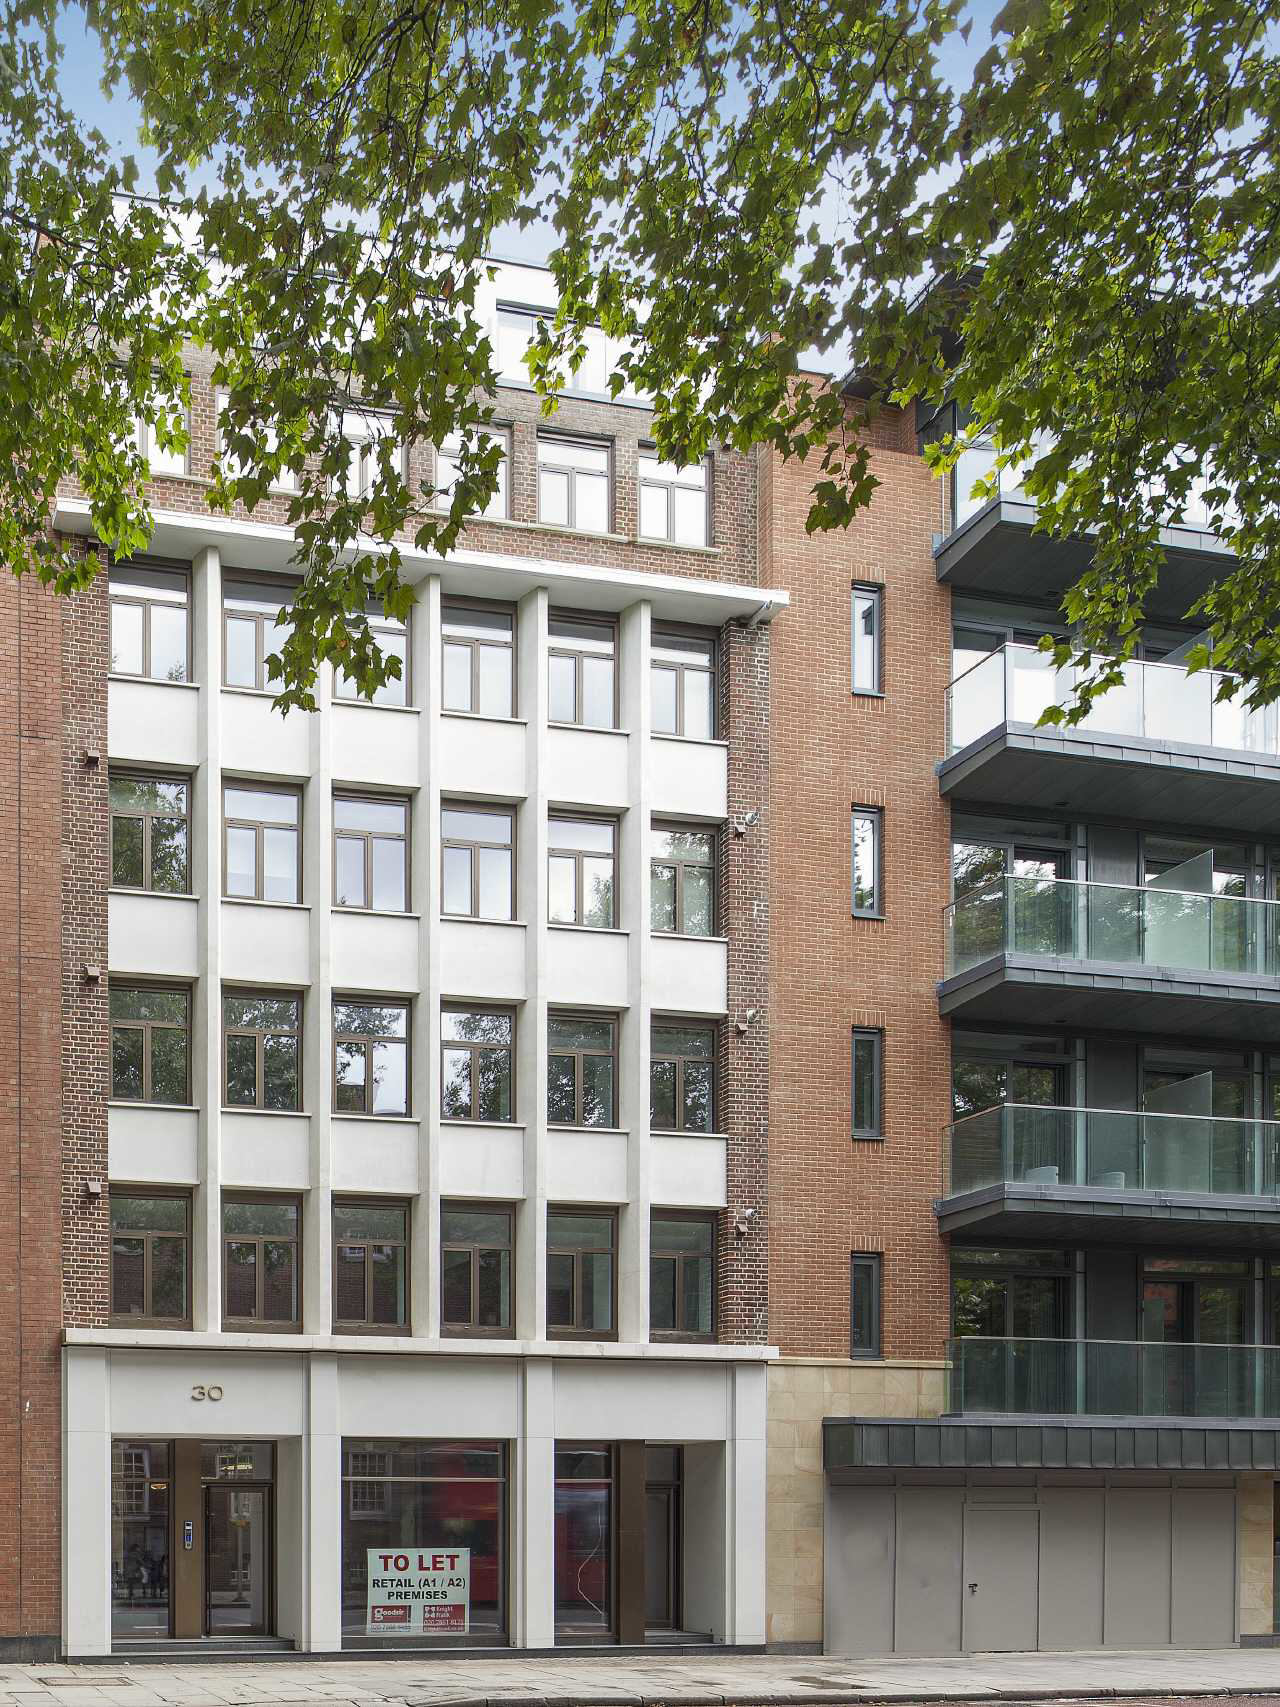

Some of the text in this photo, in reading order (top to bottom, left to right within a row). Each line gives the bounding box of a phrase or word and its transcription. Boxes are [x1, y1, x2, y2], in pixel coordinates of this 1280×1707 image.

[191, 1385, 223, 1401] 30
[378, 1554, 460, 1572] TO LET
[372, 1578, 415, 1588] RETAIL
[418, 1578, 436, 1589] (A1
[447, 1577, 466, 1589] A2)
[387, 1590, 448, 1600] PREMISES
